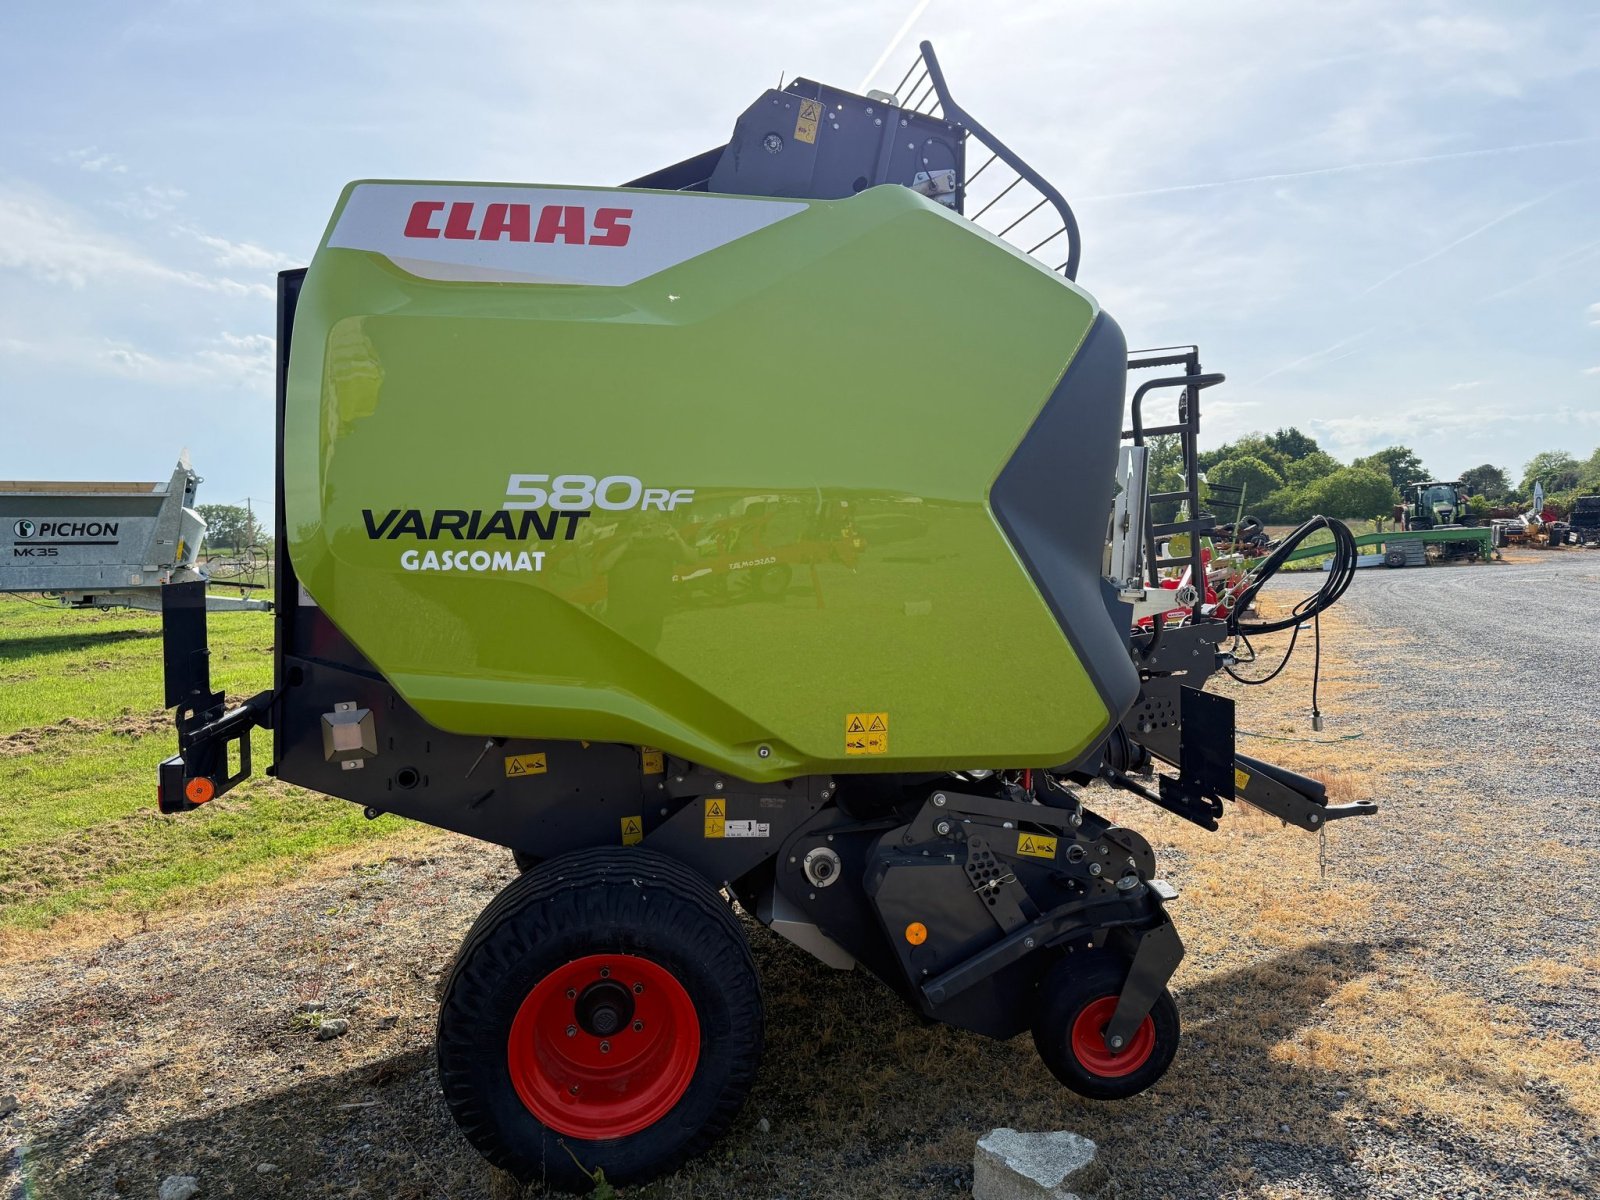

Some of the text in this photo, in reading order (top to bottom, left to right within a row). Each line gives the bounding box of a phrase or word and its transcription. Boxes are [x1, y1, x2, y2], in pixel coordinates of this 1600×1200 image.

[404, 201, 633, 247] CLAAS
[39, 522, 119, 537] PICHON
[362, 509, 591, 541] VARIANT
[401, 550, 546, 572] GASCOMAT
